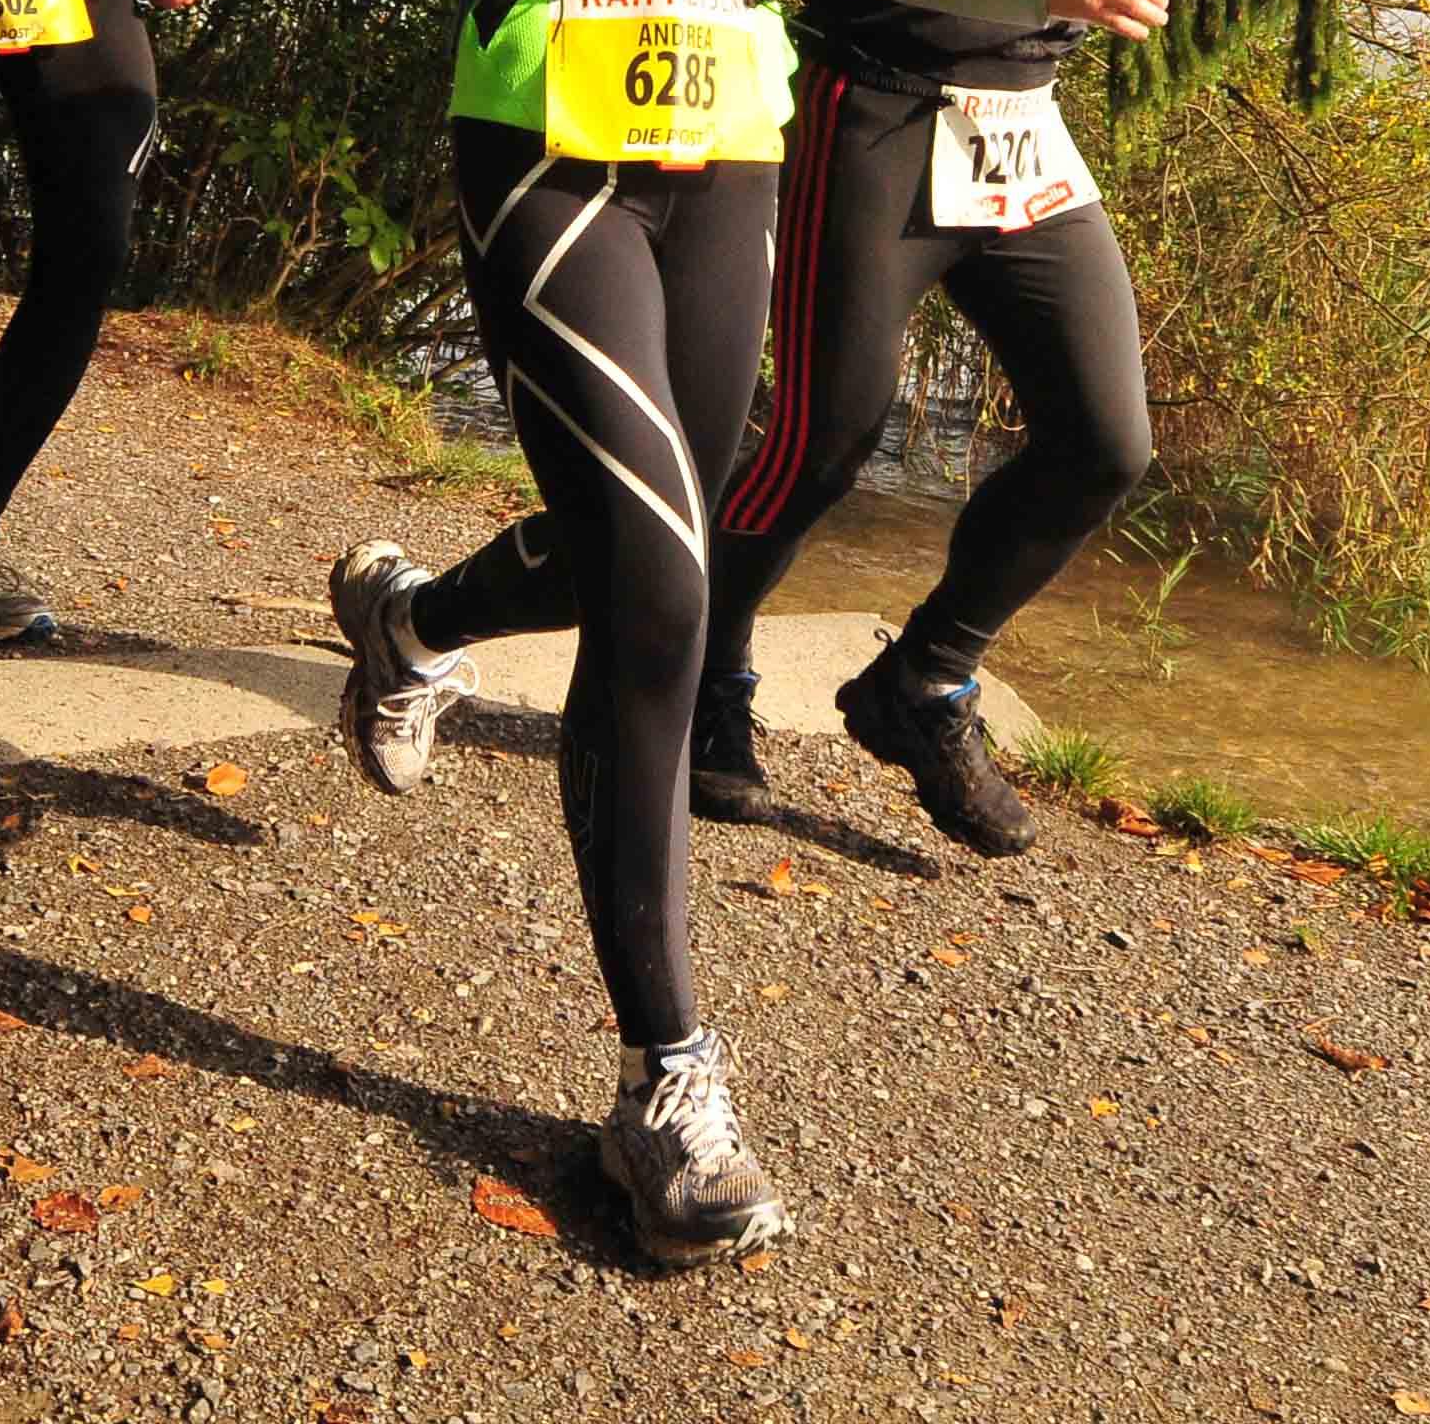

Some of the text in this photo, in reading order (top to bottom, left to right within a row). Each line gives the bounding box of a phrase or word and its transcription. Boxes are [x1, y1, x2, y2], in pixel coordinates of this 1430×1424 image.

[638, 23, 713, 48] ANDREA
[624, 51, 716, 110] 6285
[626, 128, 660, 145] DIE
